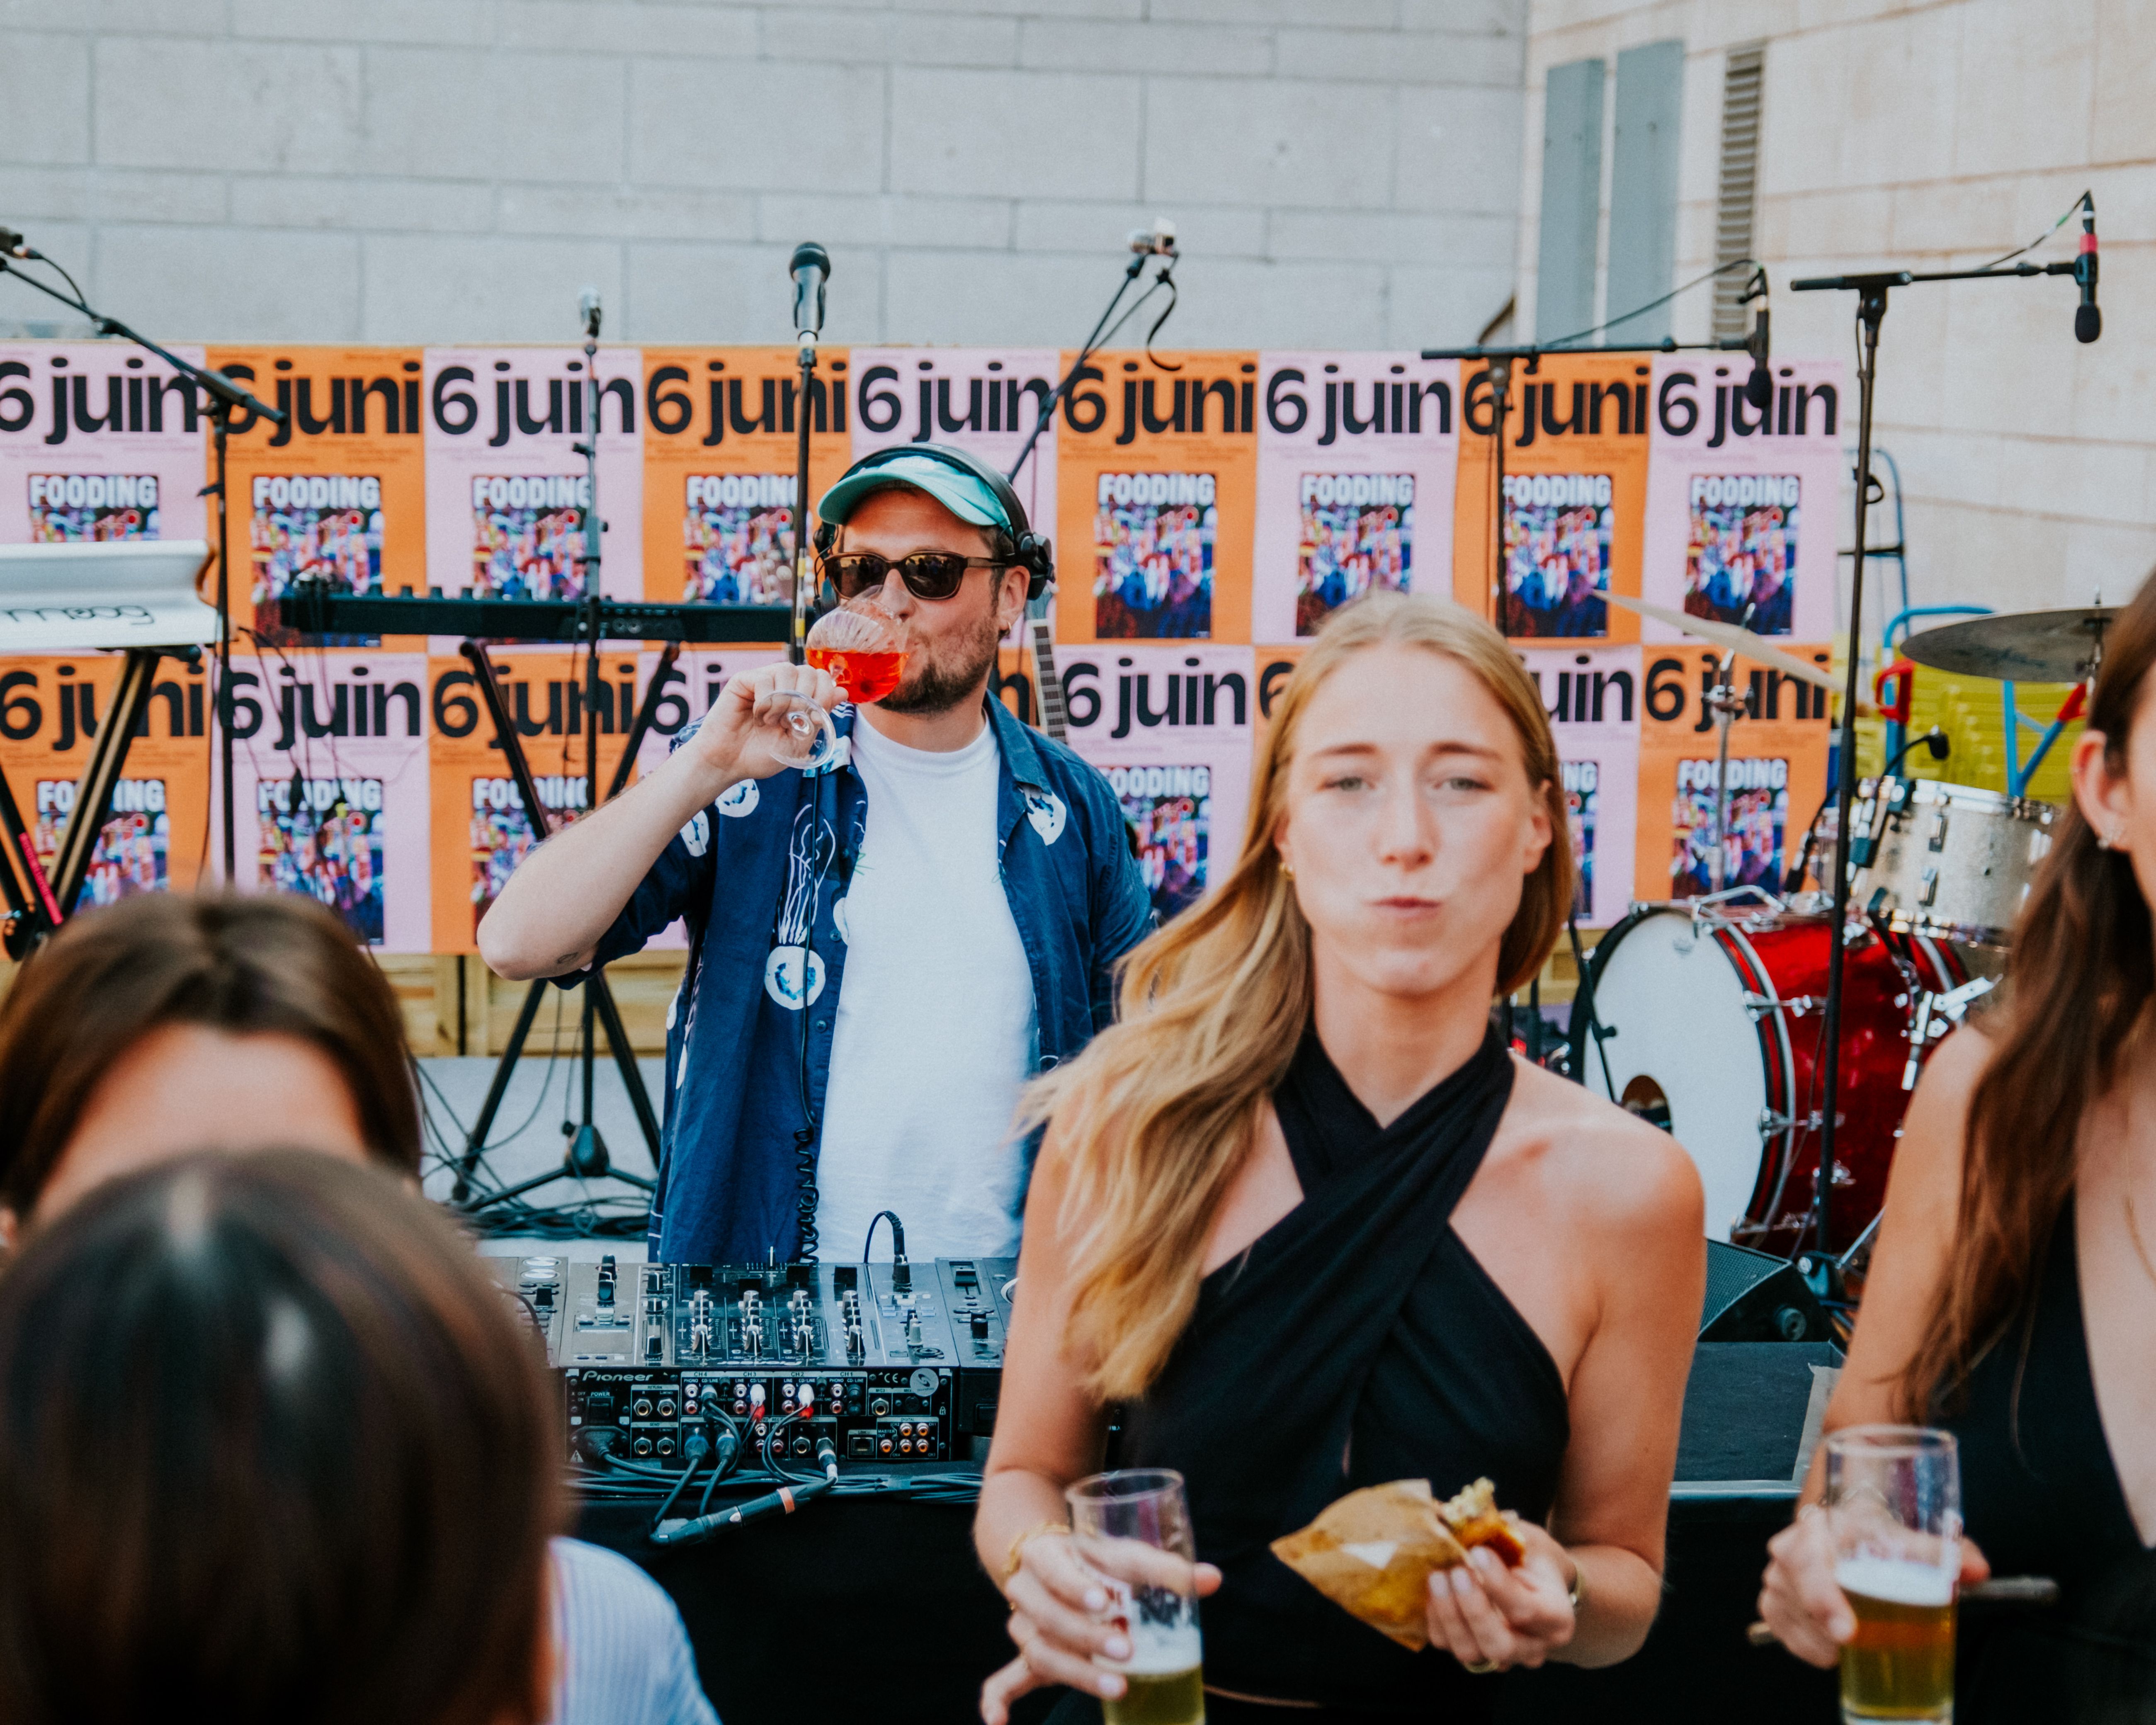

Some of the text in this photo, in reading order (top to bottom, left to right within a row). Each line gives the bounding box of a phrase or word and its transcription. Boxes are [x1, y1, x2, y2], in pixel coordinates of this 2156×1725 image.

[0, 357, 198, 445] 6 juin
[270, 361, 420, 447] juni
[433, 362, 635, 447] 6 juin
[648, 362, 846, 446] 6 juni
[858, 362, 1050, 442] 6 juin
[1064, 363, 1255, 445] 6 juni
[1267, 365, 1451, 446] 6 juin
[1515, 365, 1650, 447] juni
[1659, 368, 1837, 447] 6 juin
[29, 475, 158, 508] FOODING
[253, 476, 380, 509] FOODING
[1099, 474, 1215, 505] FOODING
[1302, 475, 1414, 506] FOODING
[1692, 475, 1800, 507] FOODING
[2, 605, 155, 625] moog
[1, 671, 42, 740] 6
[274, 666, 420, 750] juin
[434, 671, 478, 738] 6
[1062, 663, 1101, 727] 6
[1111, 658, 1246, 739] juin
[1645, 659, 1684, 721] 6
[582, 1370, 653, 1381] Pioneer
